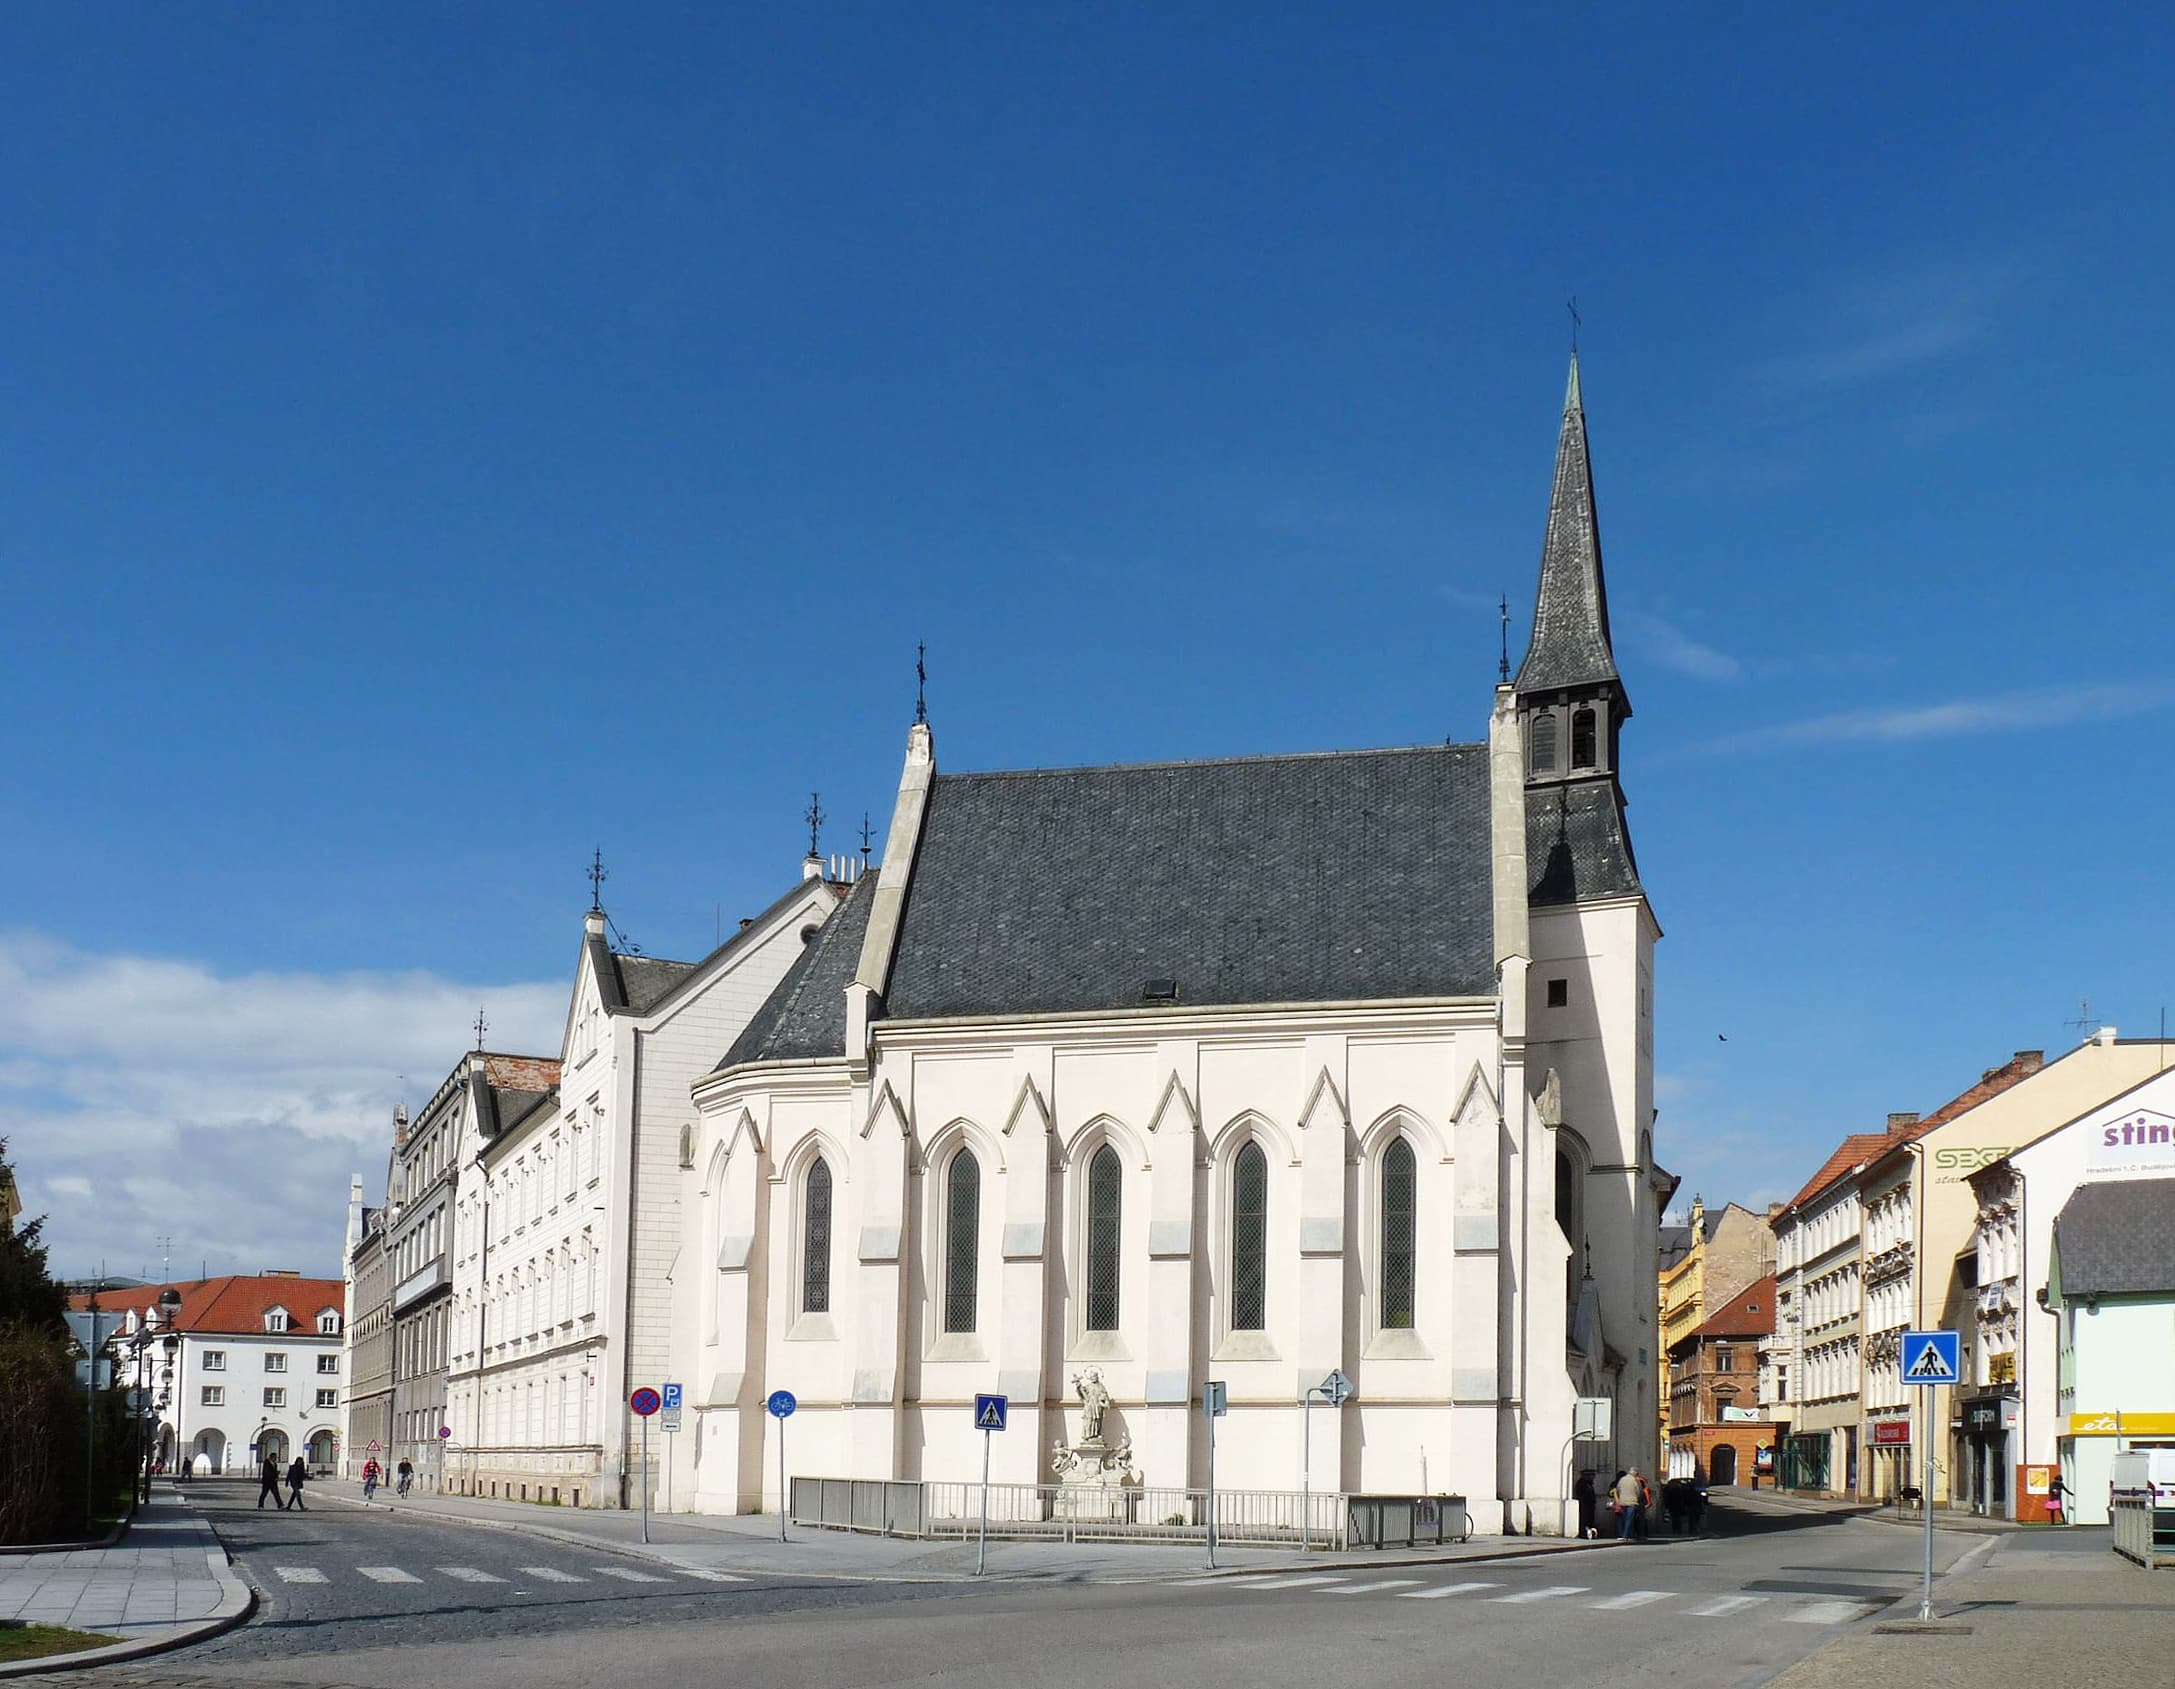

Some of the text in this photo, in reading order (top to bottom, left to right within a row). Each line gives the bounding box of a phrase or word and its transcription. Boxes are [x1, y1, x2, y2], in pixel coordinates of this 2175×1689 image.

[2103, 1118, 2175, 1149] stin
[1935, 1147, 2021, 1168] SEXT
[666, 1386, 679, 1401] P
